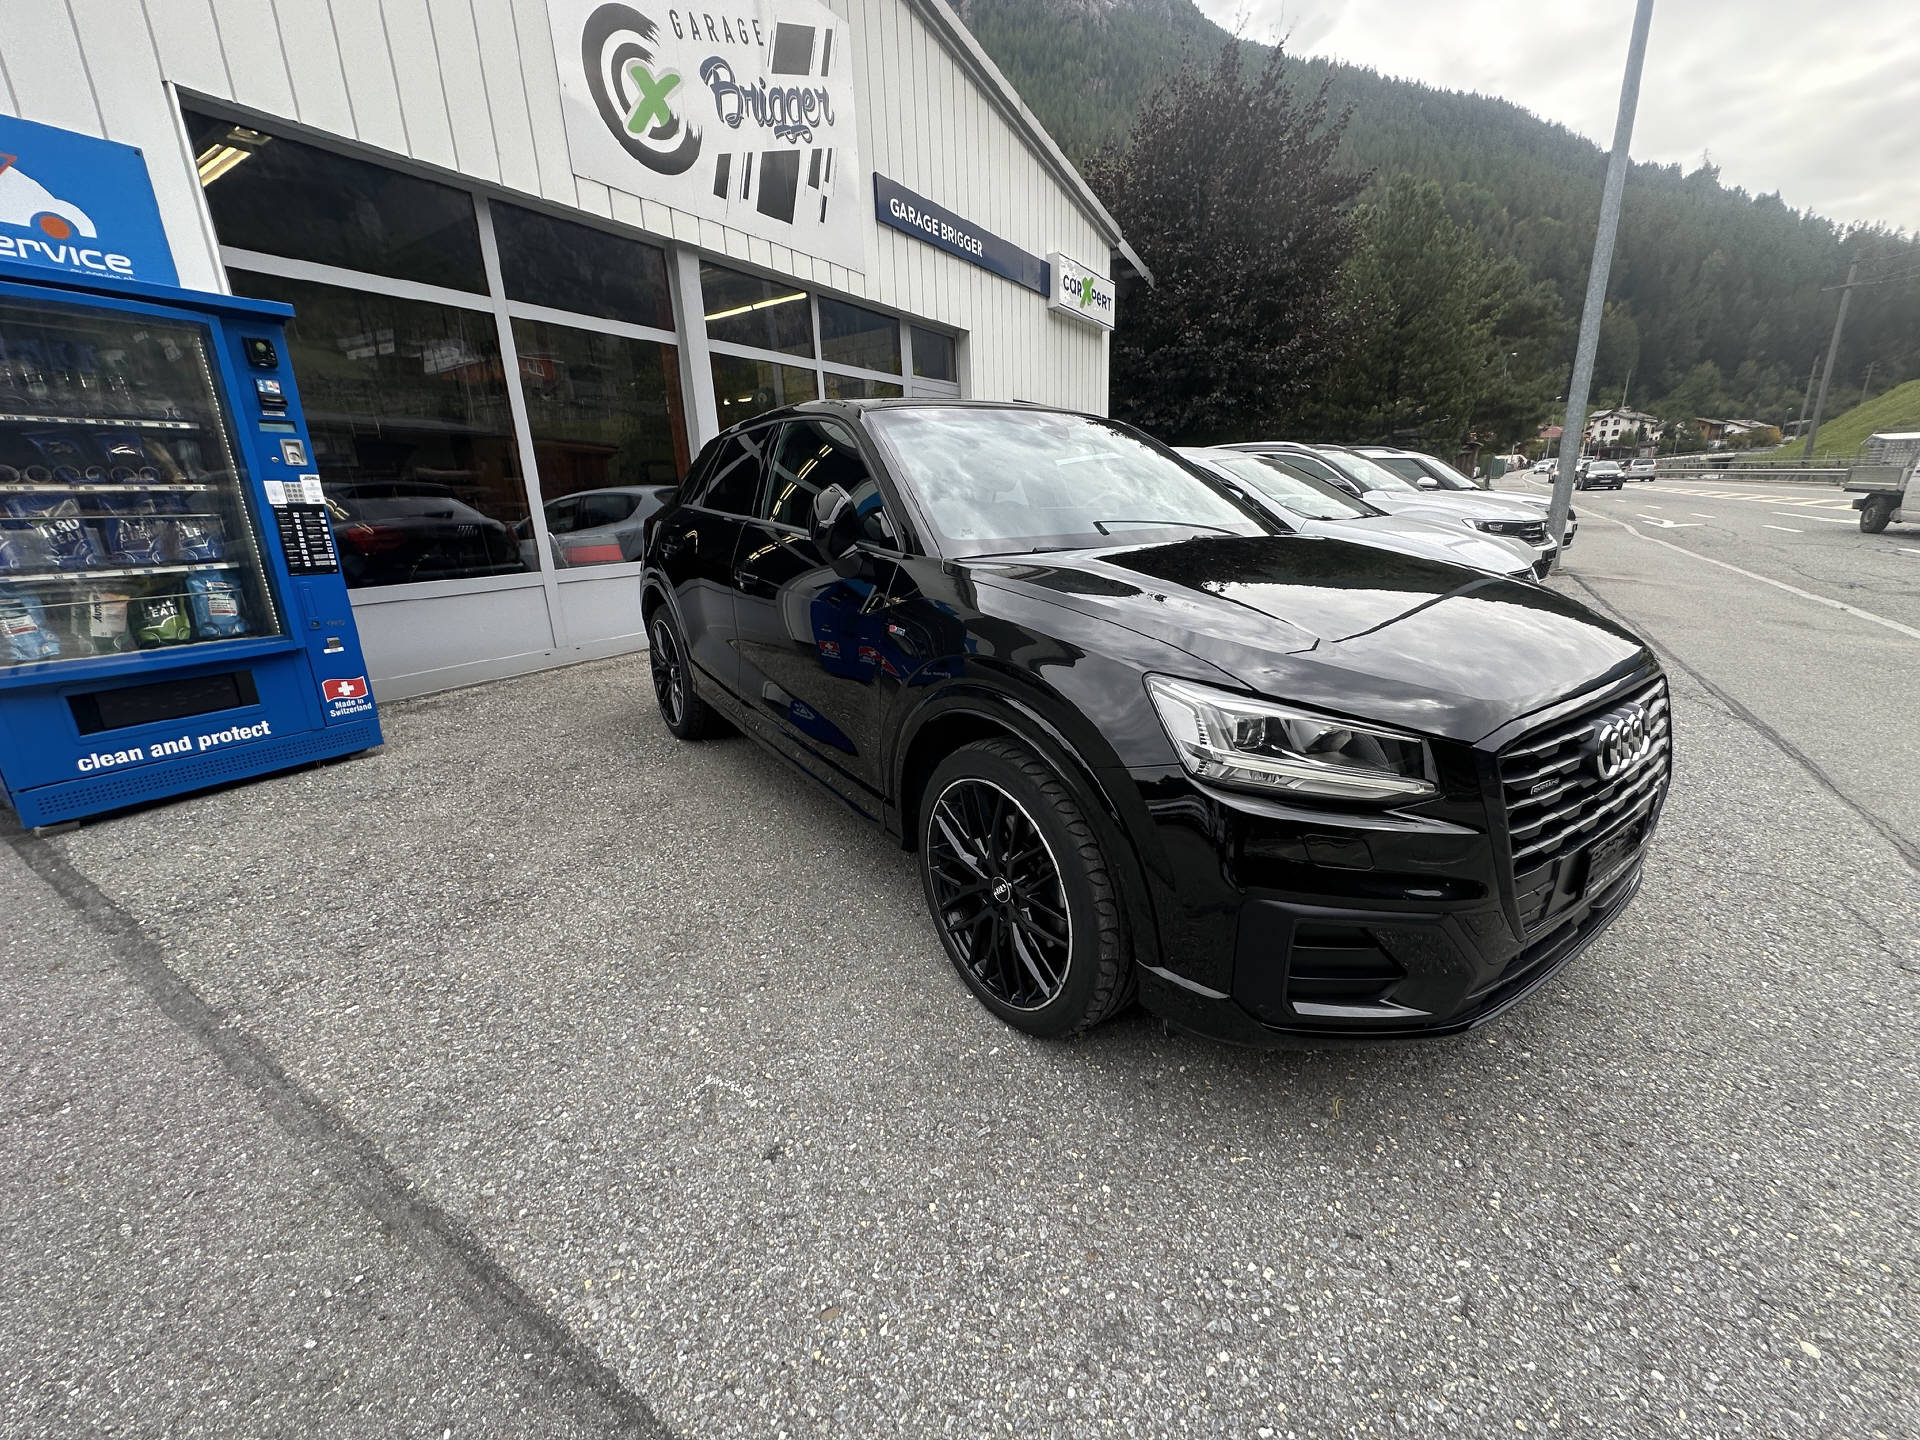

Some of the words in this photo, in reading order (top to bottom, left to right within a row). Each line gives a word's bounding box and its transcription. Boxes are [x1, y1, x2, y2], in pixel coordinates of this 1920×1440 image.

[668, 9, 765, 46] GARAGE
[699, 55, 834, 144] Brigger
[889, 198, 939, 237] GARAGE
[940, 222, 984, 258] BRIGGER
[330, 702, 372, 717] Switzerland
[334, 700, 356, 709] Made
[77, 748, 145, 772] clean
[150, 736, 193, 758] and
[197, 720, 272, 752] protect
